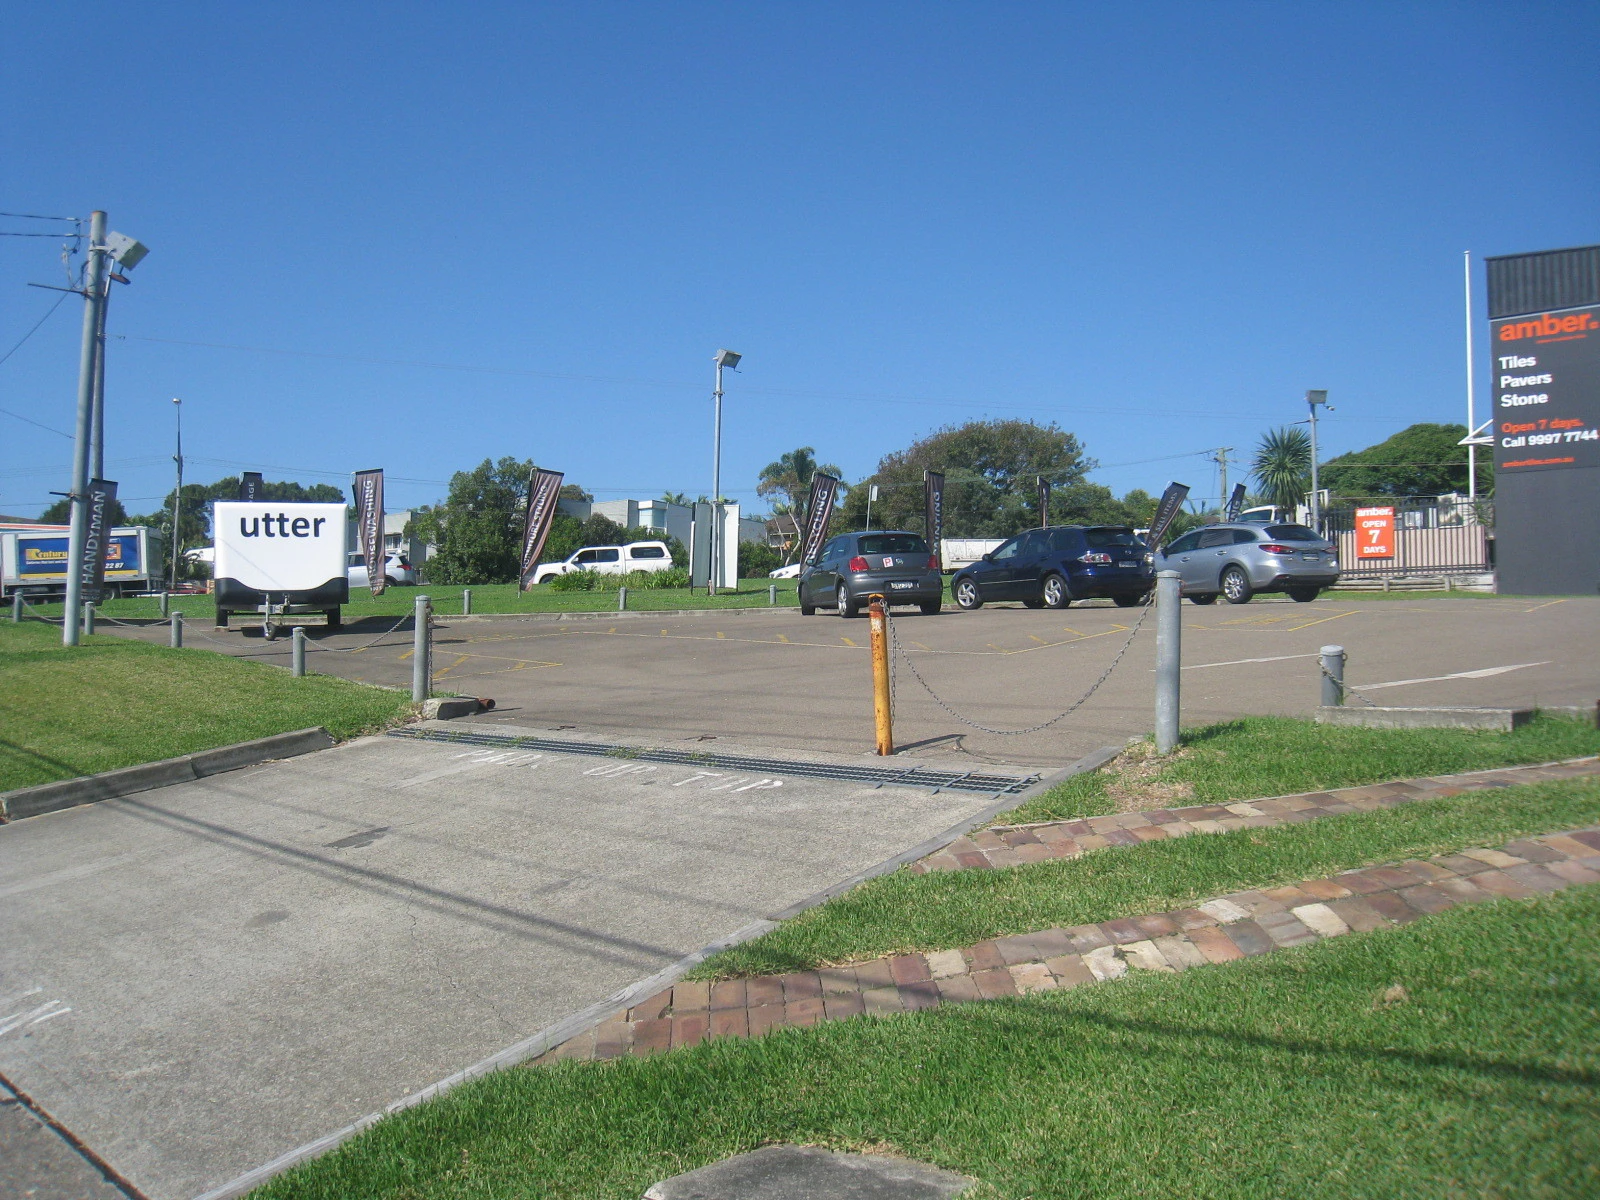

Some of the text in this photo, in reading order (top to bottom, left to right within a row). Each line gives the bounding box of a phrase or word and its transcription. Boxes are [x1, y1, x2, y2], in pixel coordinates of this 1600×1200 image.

[1499, 356, 1536, 369] Tiles
[1500, 373, 1552, 388] Pavers
[1500, 393, 1549, 407] Stone
[1501, 422, 1535, 434] Open
[1538, 419, 1548, 430] 7
[1502, 430, 1599, 448] Call 9997 7744
[240, 513, 326, 537] utter
[1362, 520, 1387, 528] OPEN
[82, 491, 106, 584] HANDYMAN
[1368, 529, 1380, 543] 7
